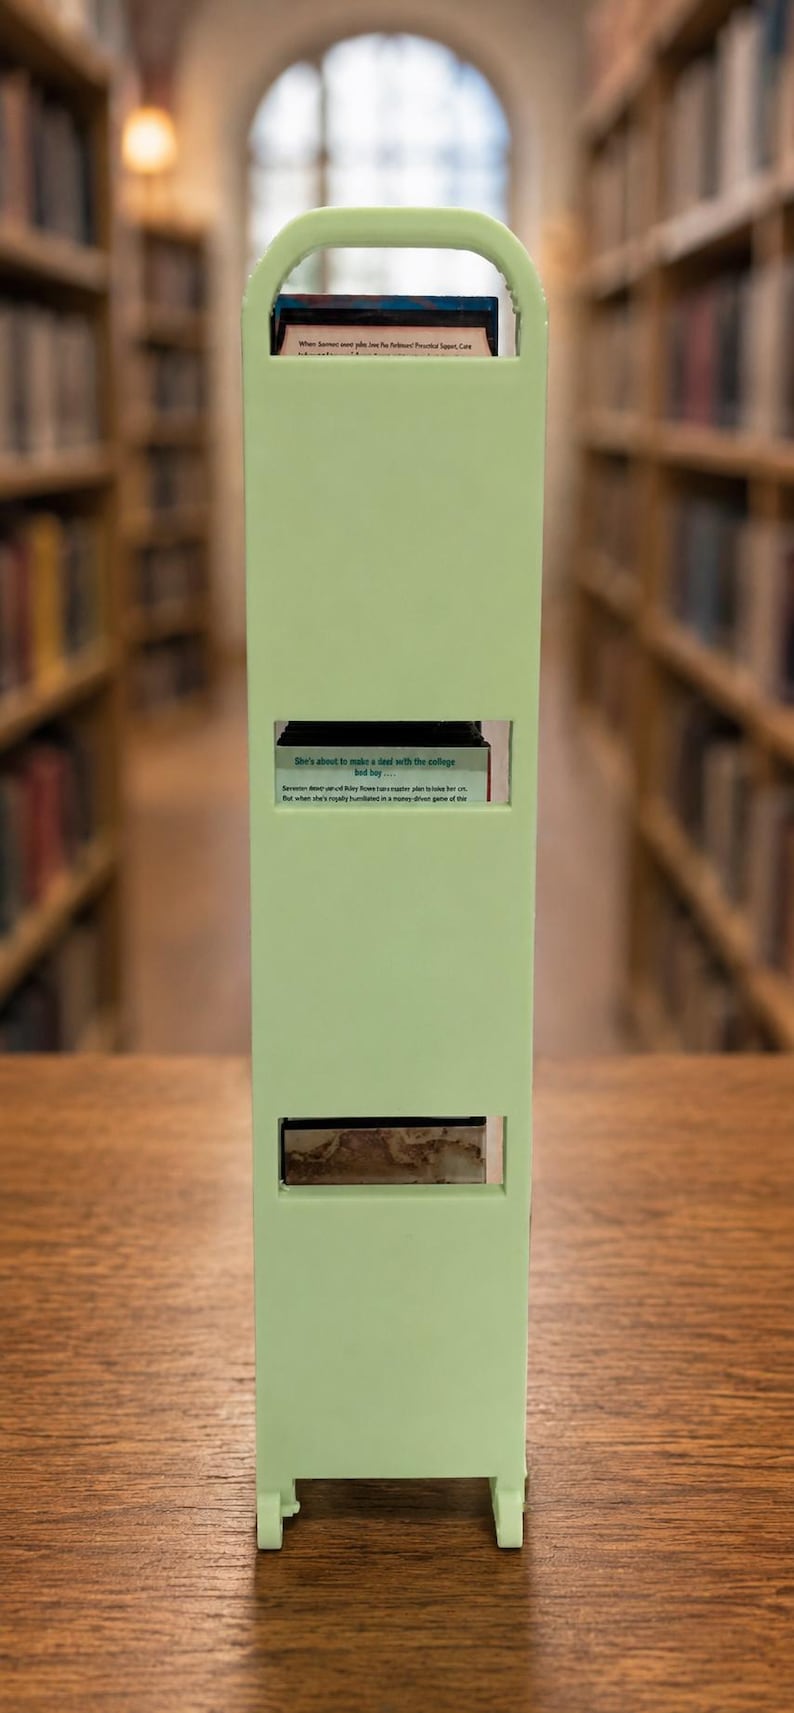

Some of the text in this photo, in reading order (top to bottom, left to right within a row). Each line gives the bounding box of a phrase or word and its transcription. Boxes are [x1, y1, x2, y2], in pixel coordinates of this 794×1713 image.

[294, 756, 314, 766] She's
[316, 757, 338, 765] about
[396, 758, 412, 766] with
[414, 757, 426, 766] the
[428, 758, 456, 768] college
[370, 769, 382, 778] boy
